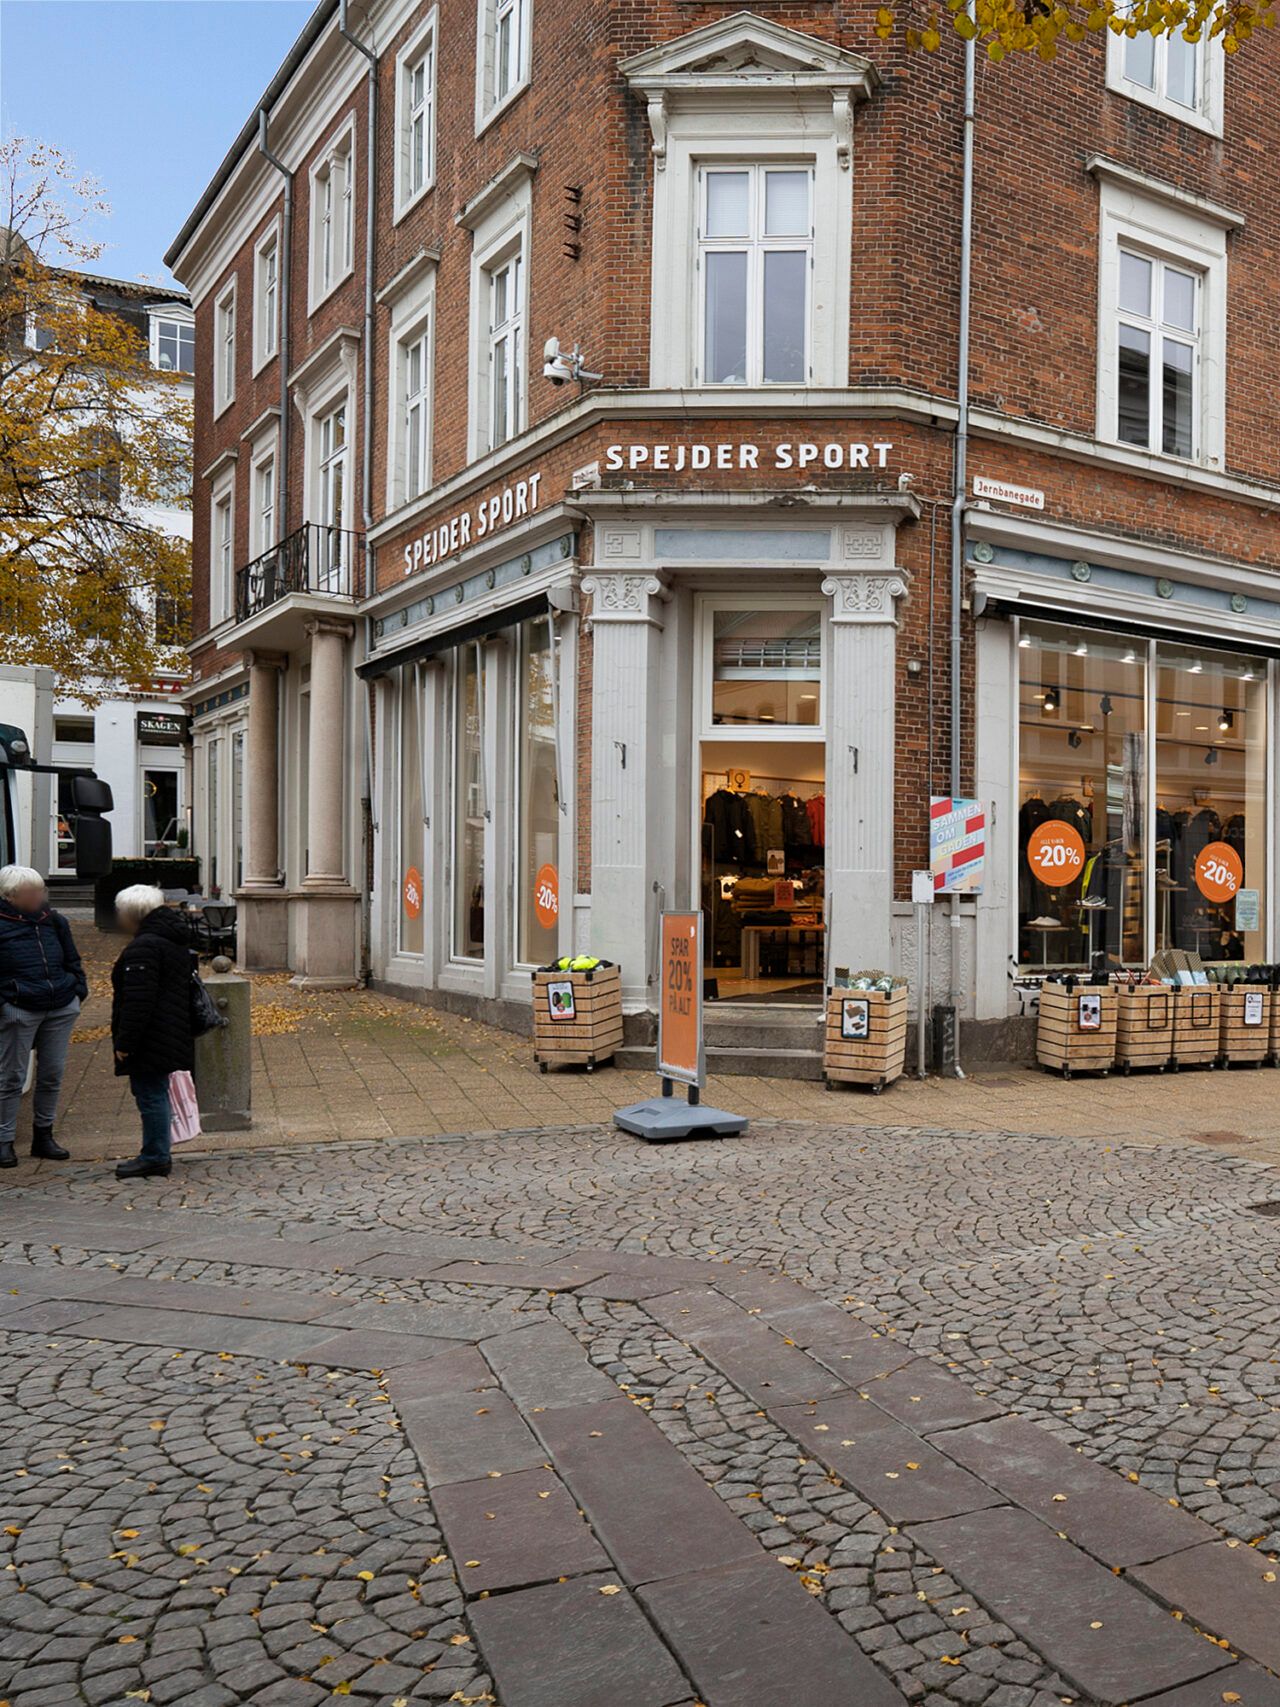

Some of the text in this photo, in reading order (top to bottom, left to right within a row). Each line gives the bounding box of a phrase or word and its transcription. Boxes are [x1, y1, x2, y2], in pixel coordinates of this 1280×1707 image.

[605, 443, 894, 472] SPEJDER SPORT
[978, 481, 1040, 505] Jernbanegade
[404, 472, 541, 576] SPEJDER SPORT
[140, 719, 181, 731] SKAGEN
[932, 803, 982, 831] SAMMEN
[936, 826, 955, 844] OM
[1033, 845, 1081, 867] -20%
[1200, 860, 1237, 892] -20%
[536, 885, 558, 914] -20%
[671, 937, 689, 957] SPAR
[668, 959, 693, 992] 20%
